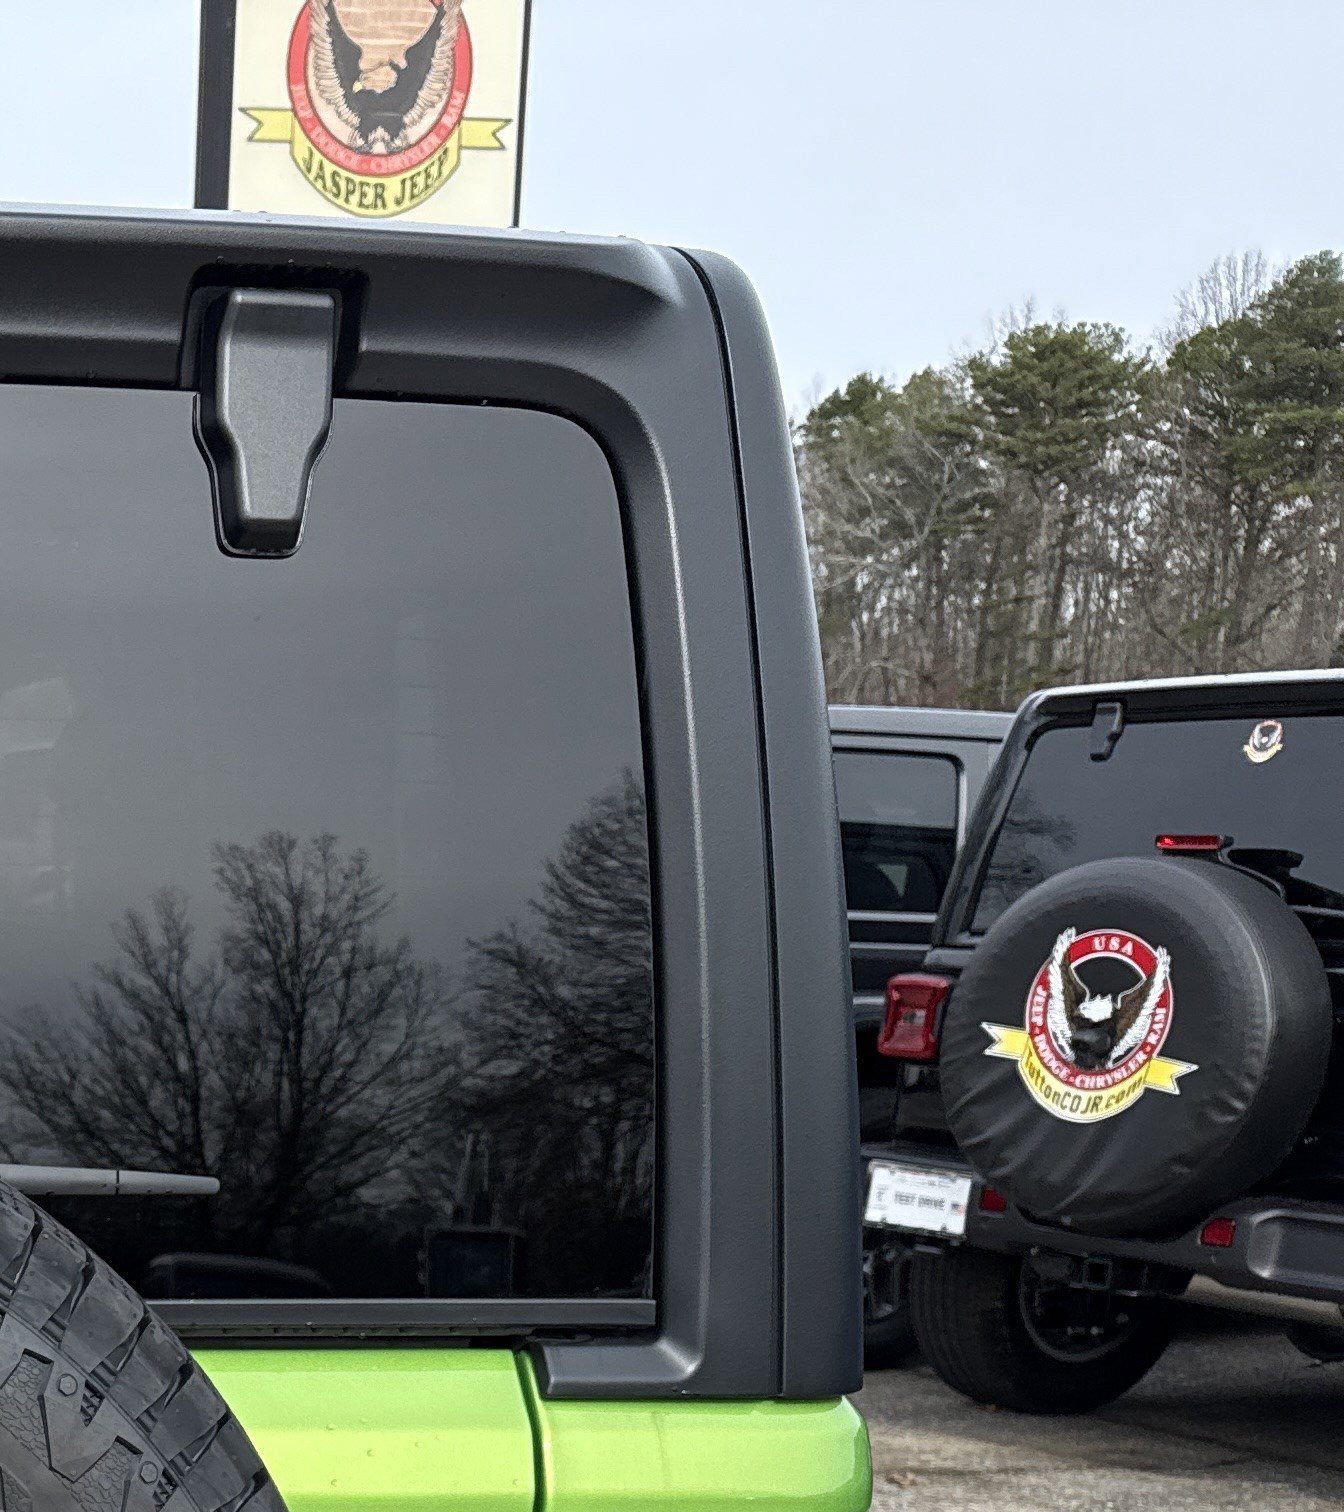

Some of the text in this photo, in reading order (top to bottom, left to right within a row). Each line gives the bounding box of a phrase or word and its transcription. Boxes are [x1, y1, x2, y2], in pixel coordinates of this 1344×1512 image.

[302, 147, 450, 210] JASPER JEEP
[1093, 937, 1134, 956] USA
